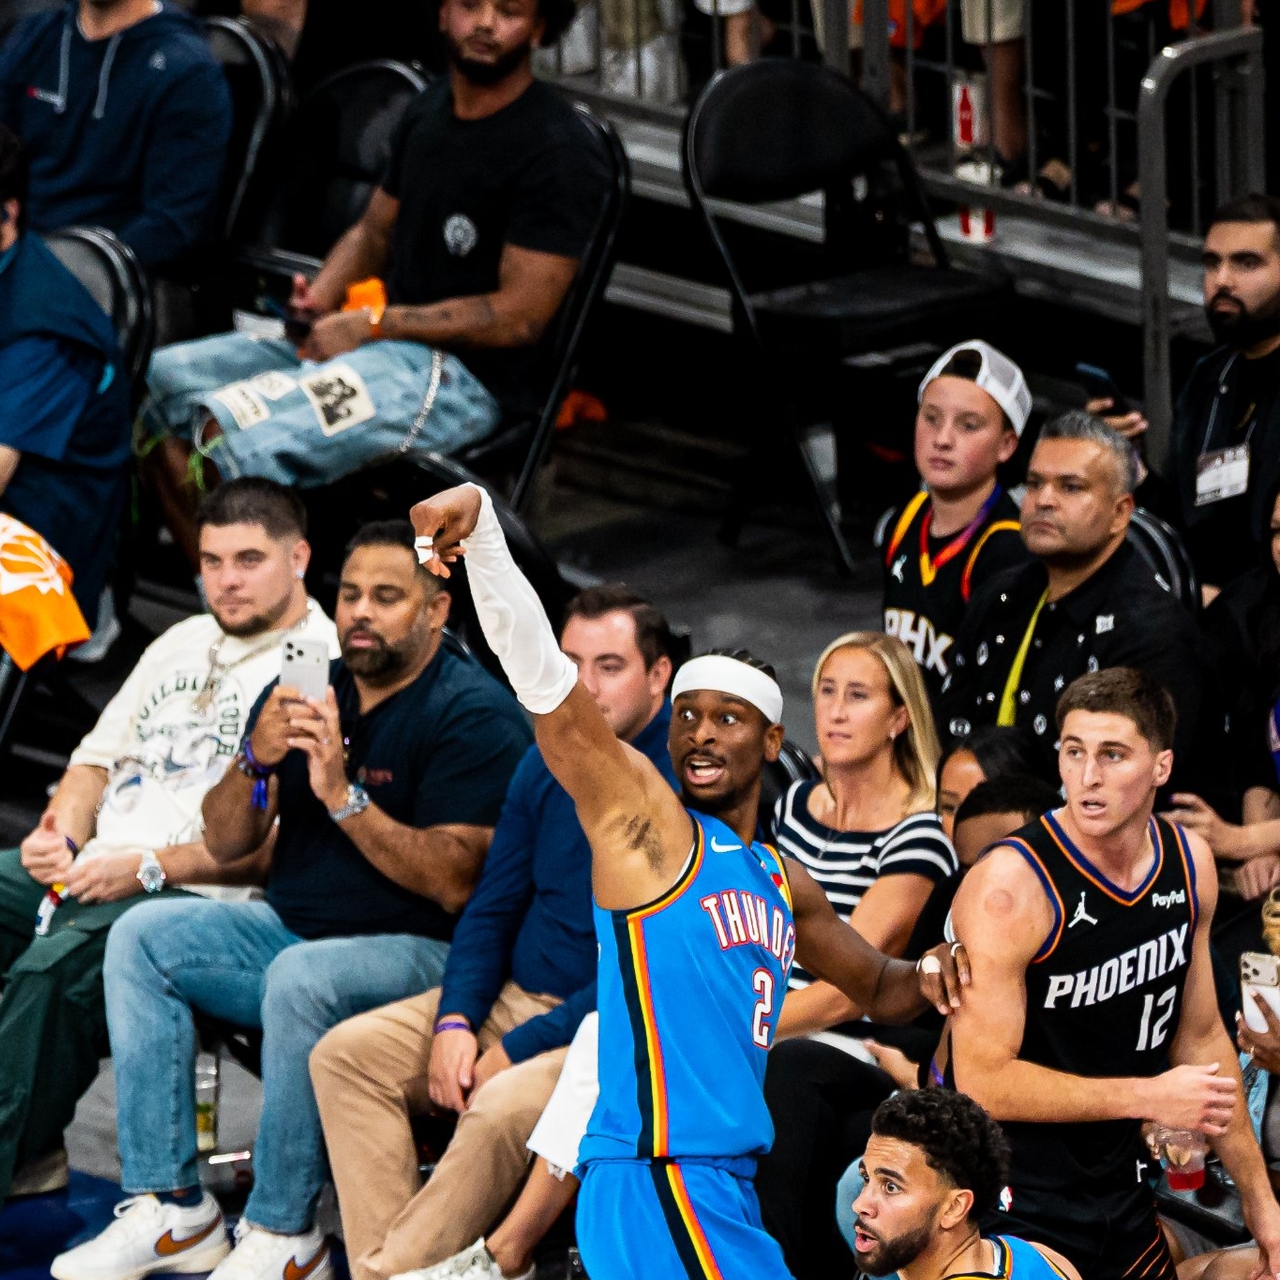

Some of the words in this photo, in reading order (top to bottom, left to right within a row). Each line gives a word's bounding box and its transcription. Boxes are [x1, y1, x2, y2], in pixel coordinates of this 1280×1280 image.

[884, 608, 954, 677] PHX
[1151, 889, 1186, 909] PayPal
[1043, 921, 1189, 1010] PHOENIX
[752, 967, 775, 1051] 2
[1135, 985, 1178, 1052] 12
